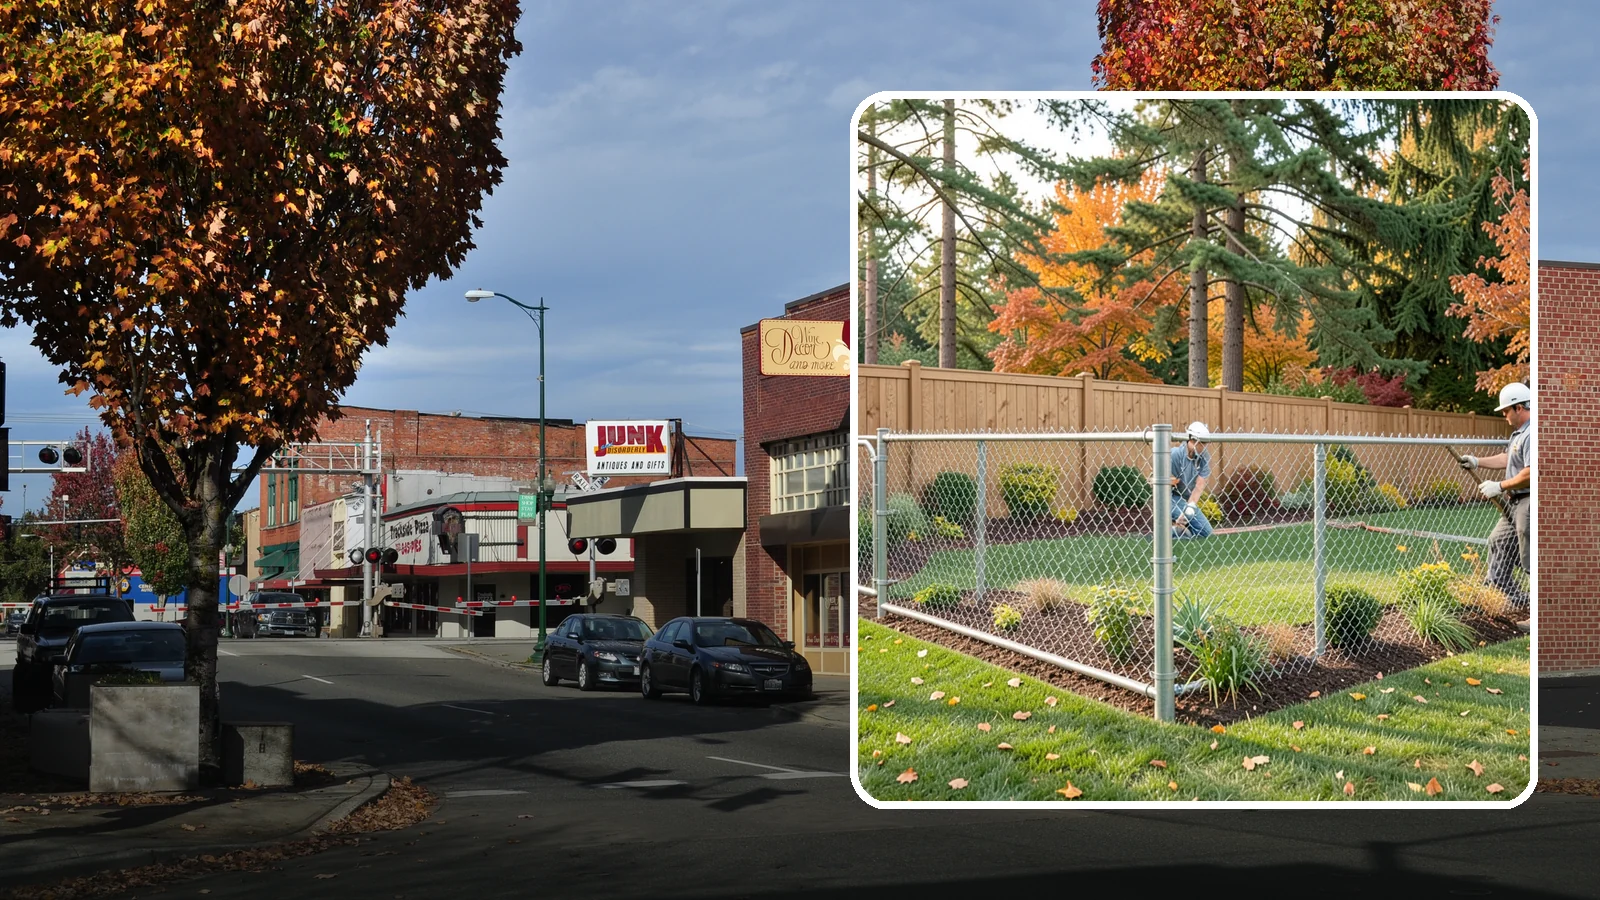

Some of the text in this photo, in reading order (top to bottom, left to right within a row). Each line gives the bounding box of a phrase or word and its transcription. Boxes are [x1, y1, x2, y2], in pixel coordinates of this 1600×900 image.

[596, 425, 665, 457] JUNK
[607, 446, 646, 454] DISORDERLY
[597, 460, 665, 470] ANTIQUES AND GIFTS
[573, 473, 588, 491] RAIL
[390, 519, 429, 539] Trackside Pizza
